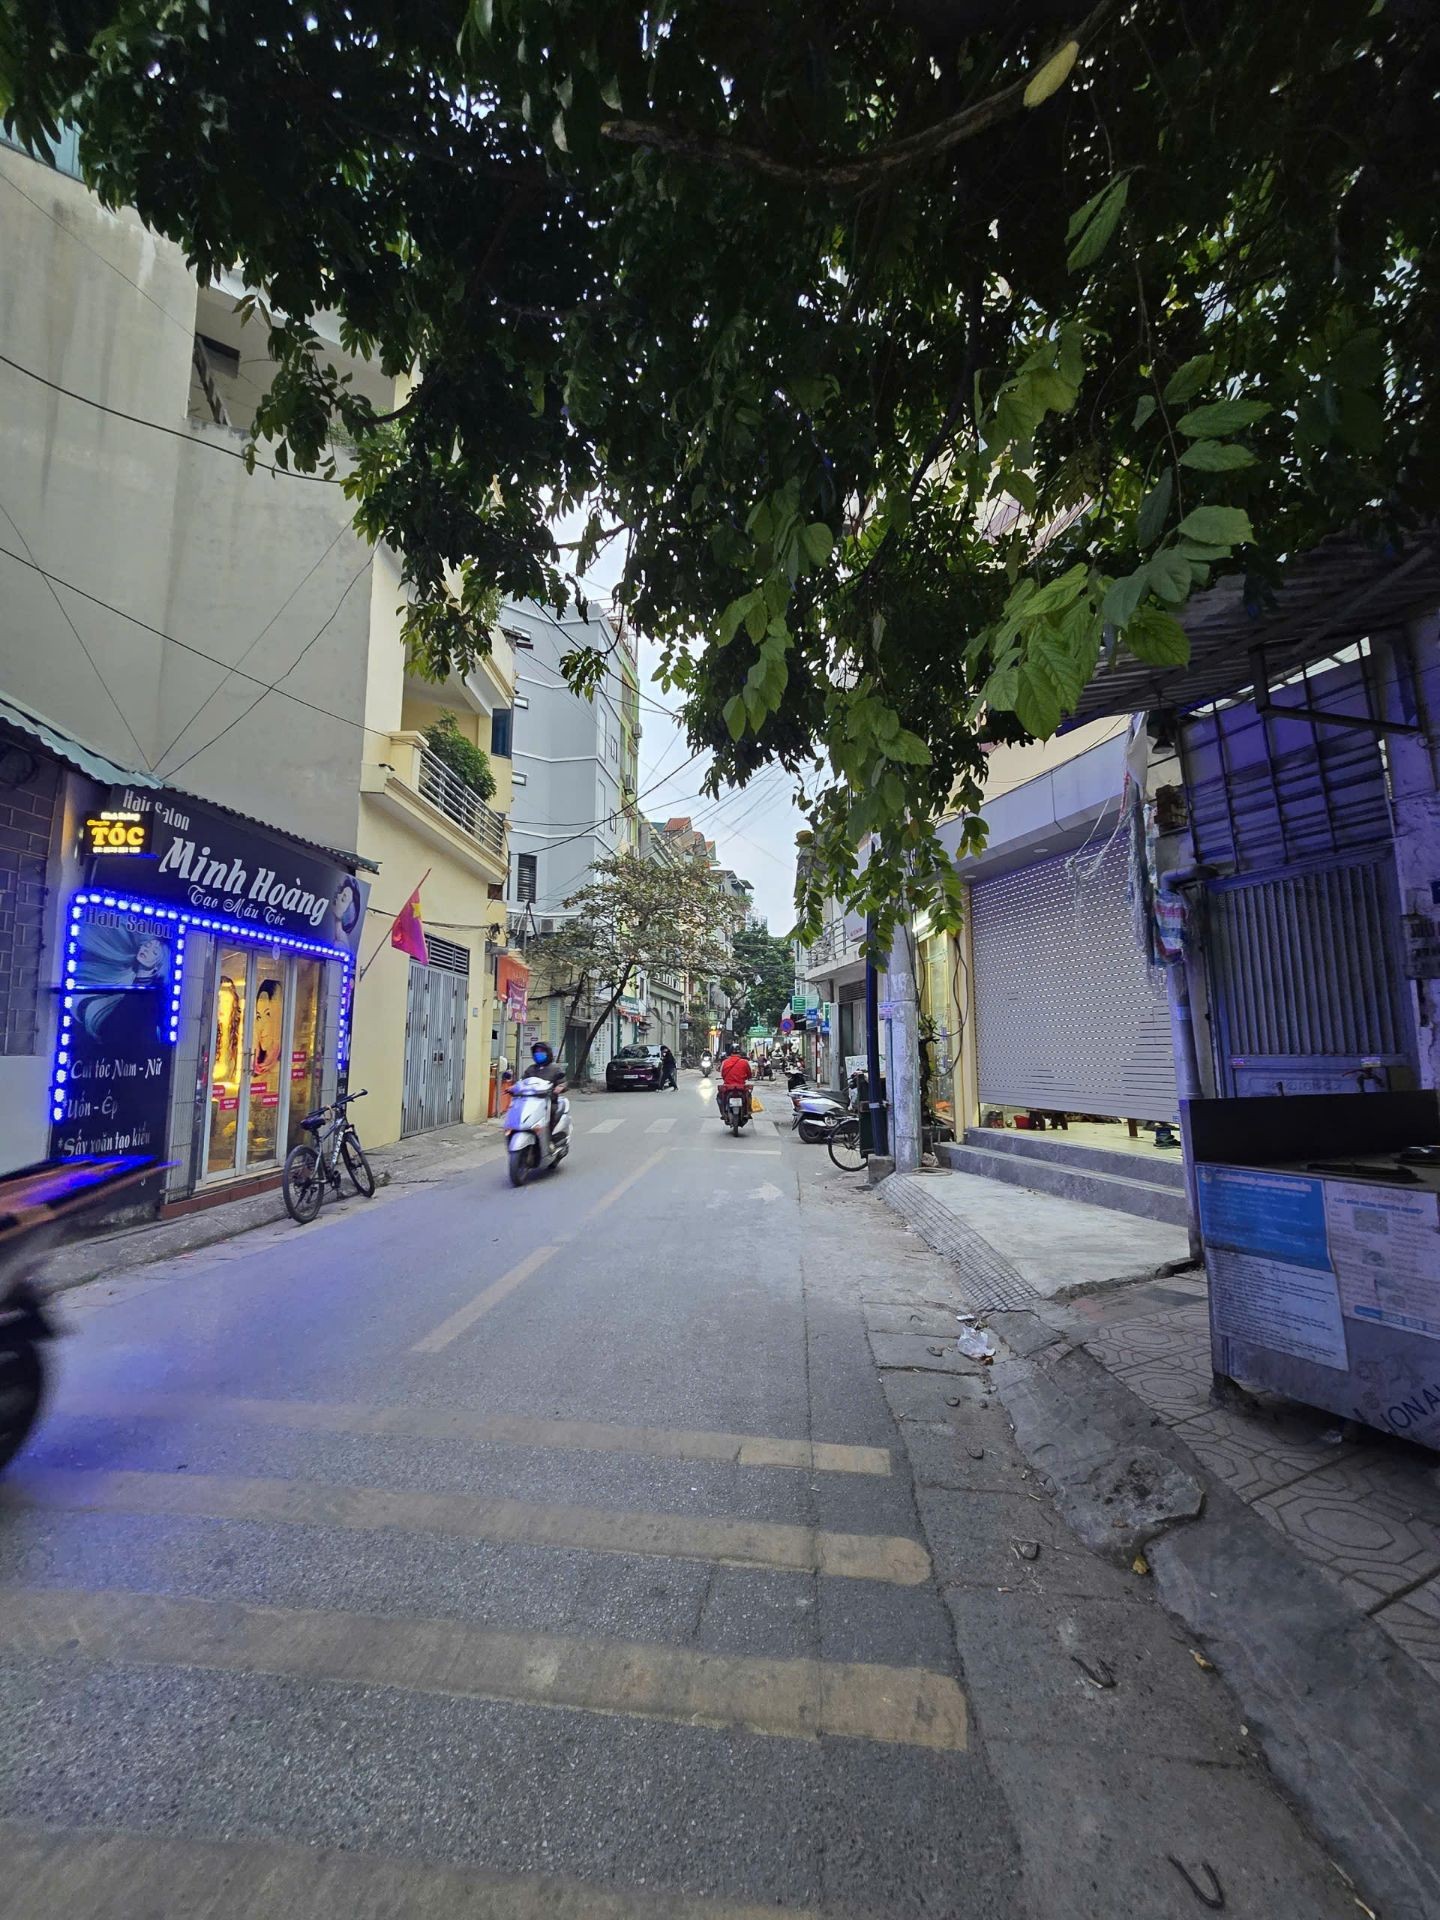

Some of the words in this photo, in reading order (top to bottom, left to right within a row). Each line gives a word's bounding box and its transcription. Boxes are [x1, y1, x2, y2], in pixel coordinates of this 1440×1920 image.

[122, 788, 153, 812] Hair
[91, 822, 145, 846] TÓC
[158, 836, 248, 894] Minh
[248, 867, 330, 926] Hoàng
[187, 884, 219, 909] Tạo
[262, 906, 286, 926] Tóc
[84, 904, 121, 929] Hair
[126, 913, 174, 939] Salon
[95, 1057, 111, 1078] tóc
[112, 1059, 138, 1080] Nam
[115, 1131, 131, 1155] tạo
